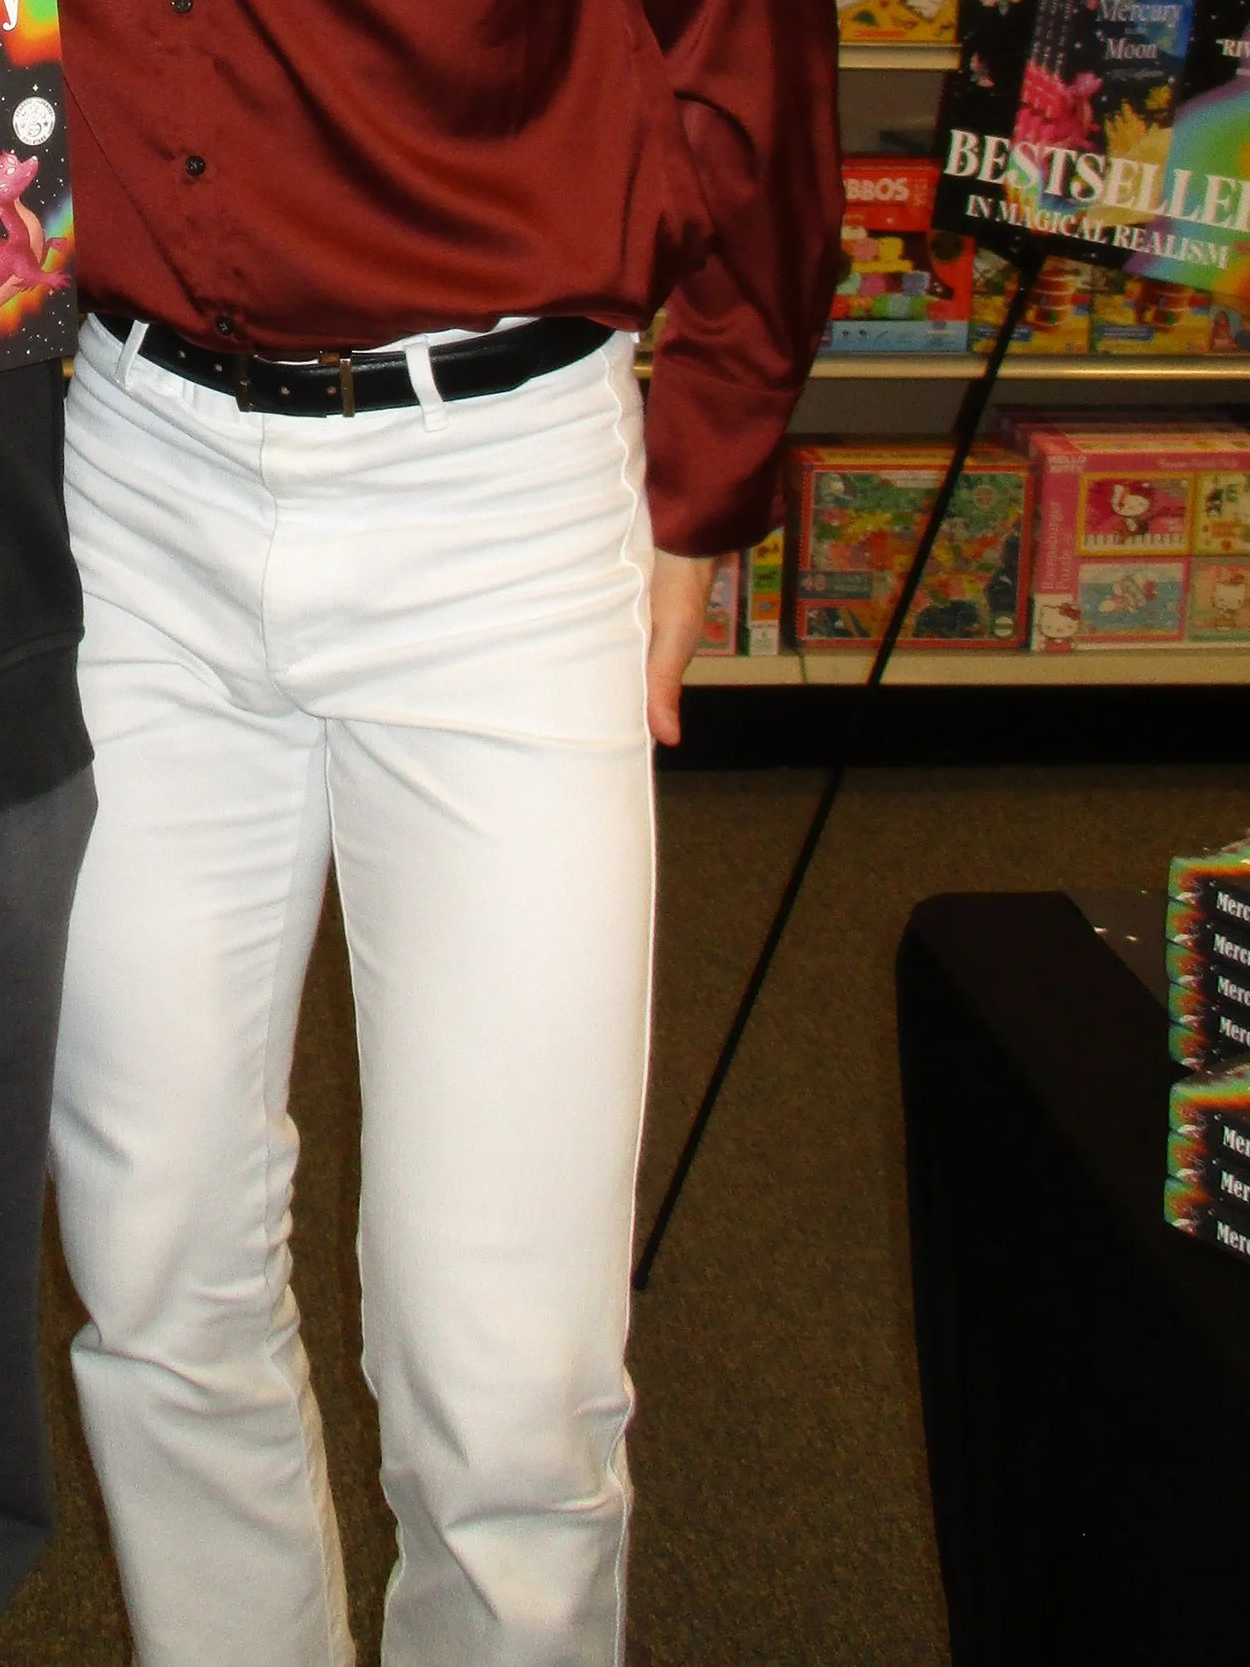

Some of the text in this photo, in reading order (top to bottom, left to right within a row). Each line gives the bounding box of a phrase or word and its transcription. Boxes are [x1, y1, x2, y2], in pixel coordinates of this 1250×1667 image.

[1103, 37, 1159, 60] Moon
[964, 194, 1229, 271] IN MAGICAL REALISM
